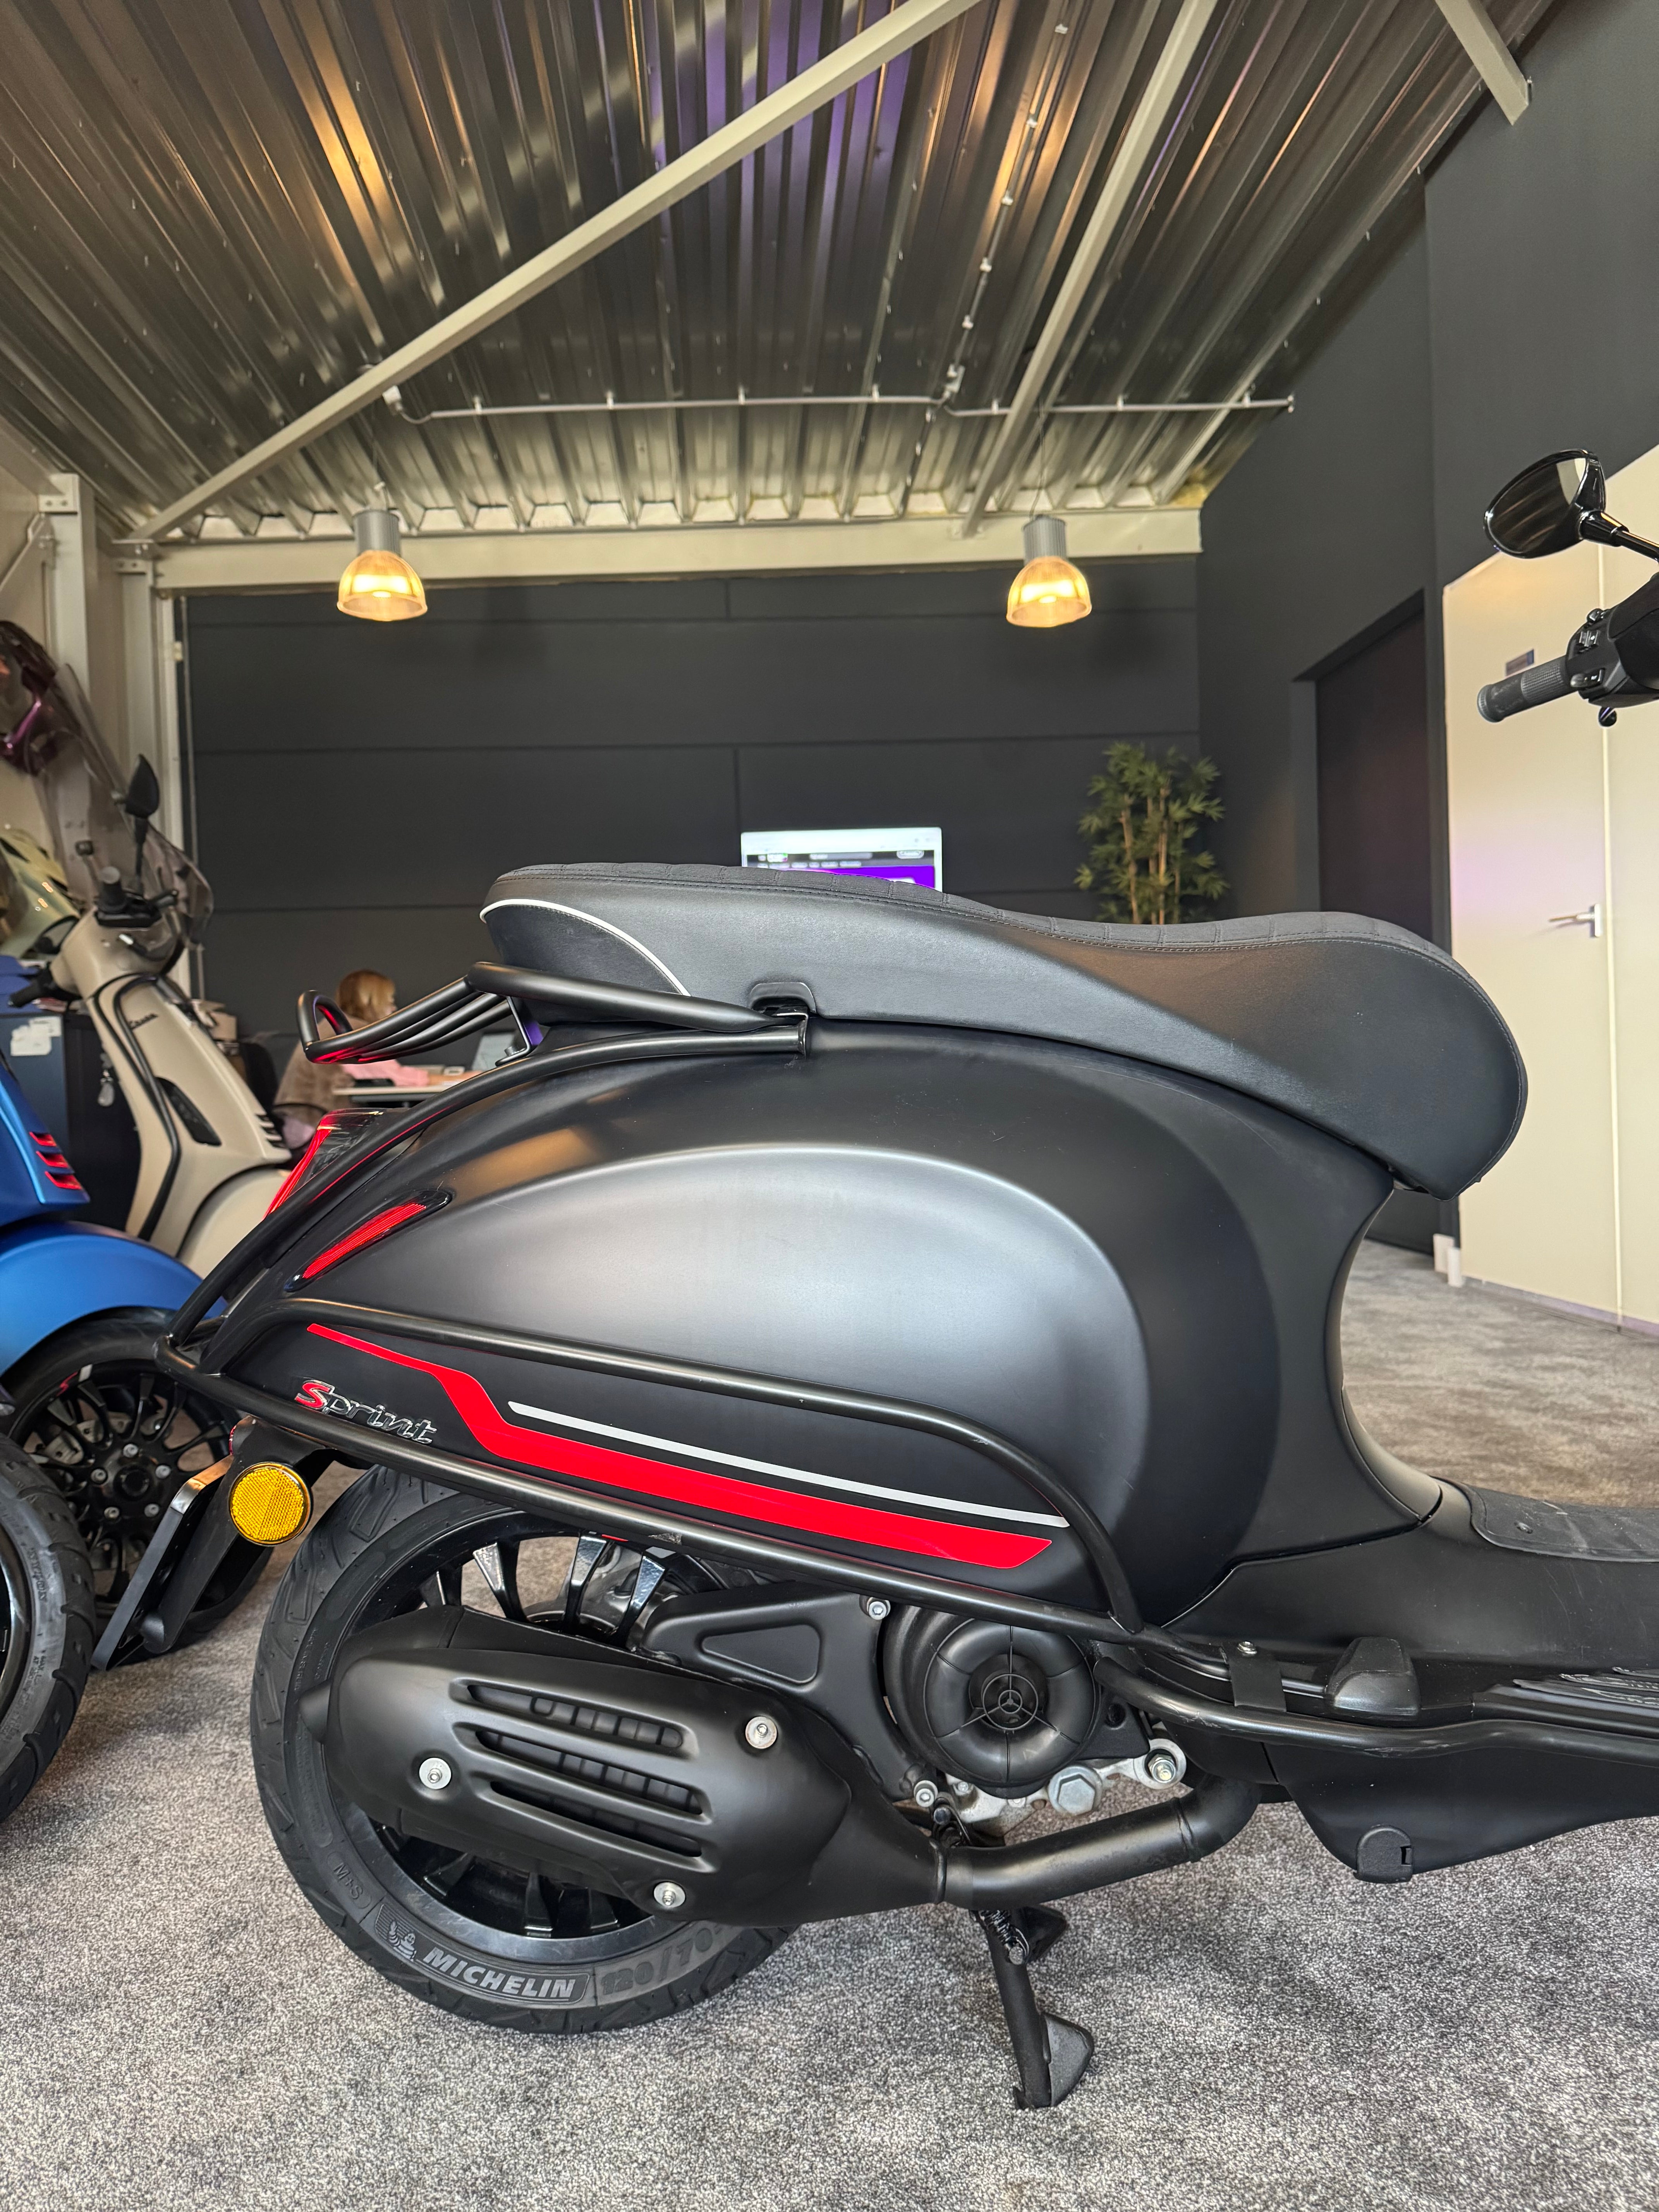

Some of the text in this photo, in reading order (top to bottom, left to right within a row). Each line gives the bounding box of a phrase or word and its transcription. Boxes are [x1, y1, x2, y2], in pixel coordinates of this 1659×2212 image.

[295, 1379, 437, 1444] Sprint
[333, 1862, 363, 1899] M+S
[423, 1947, 575, 1998] MICHELIN
